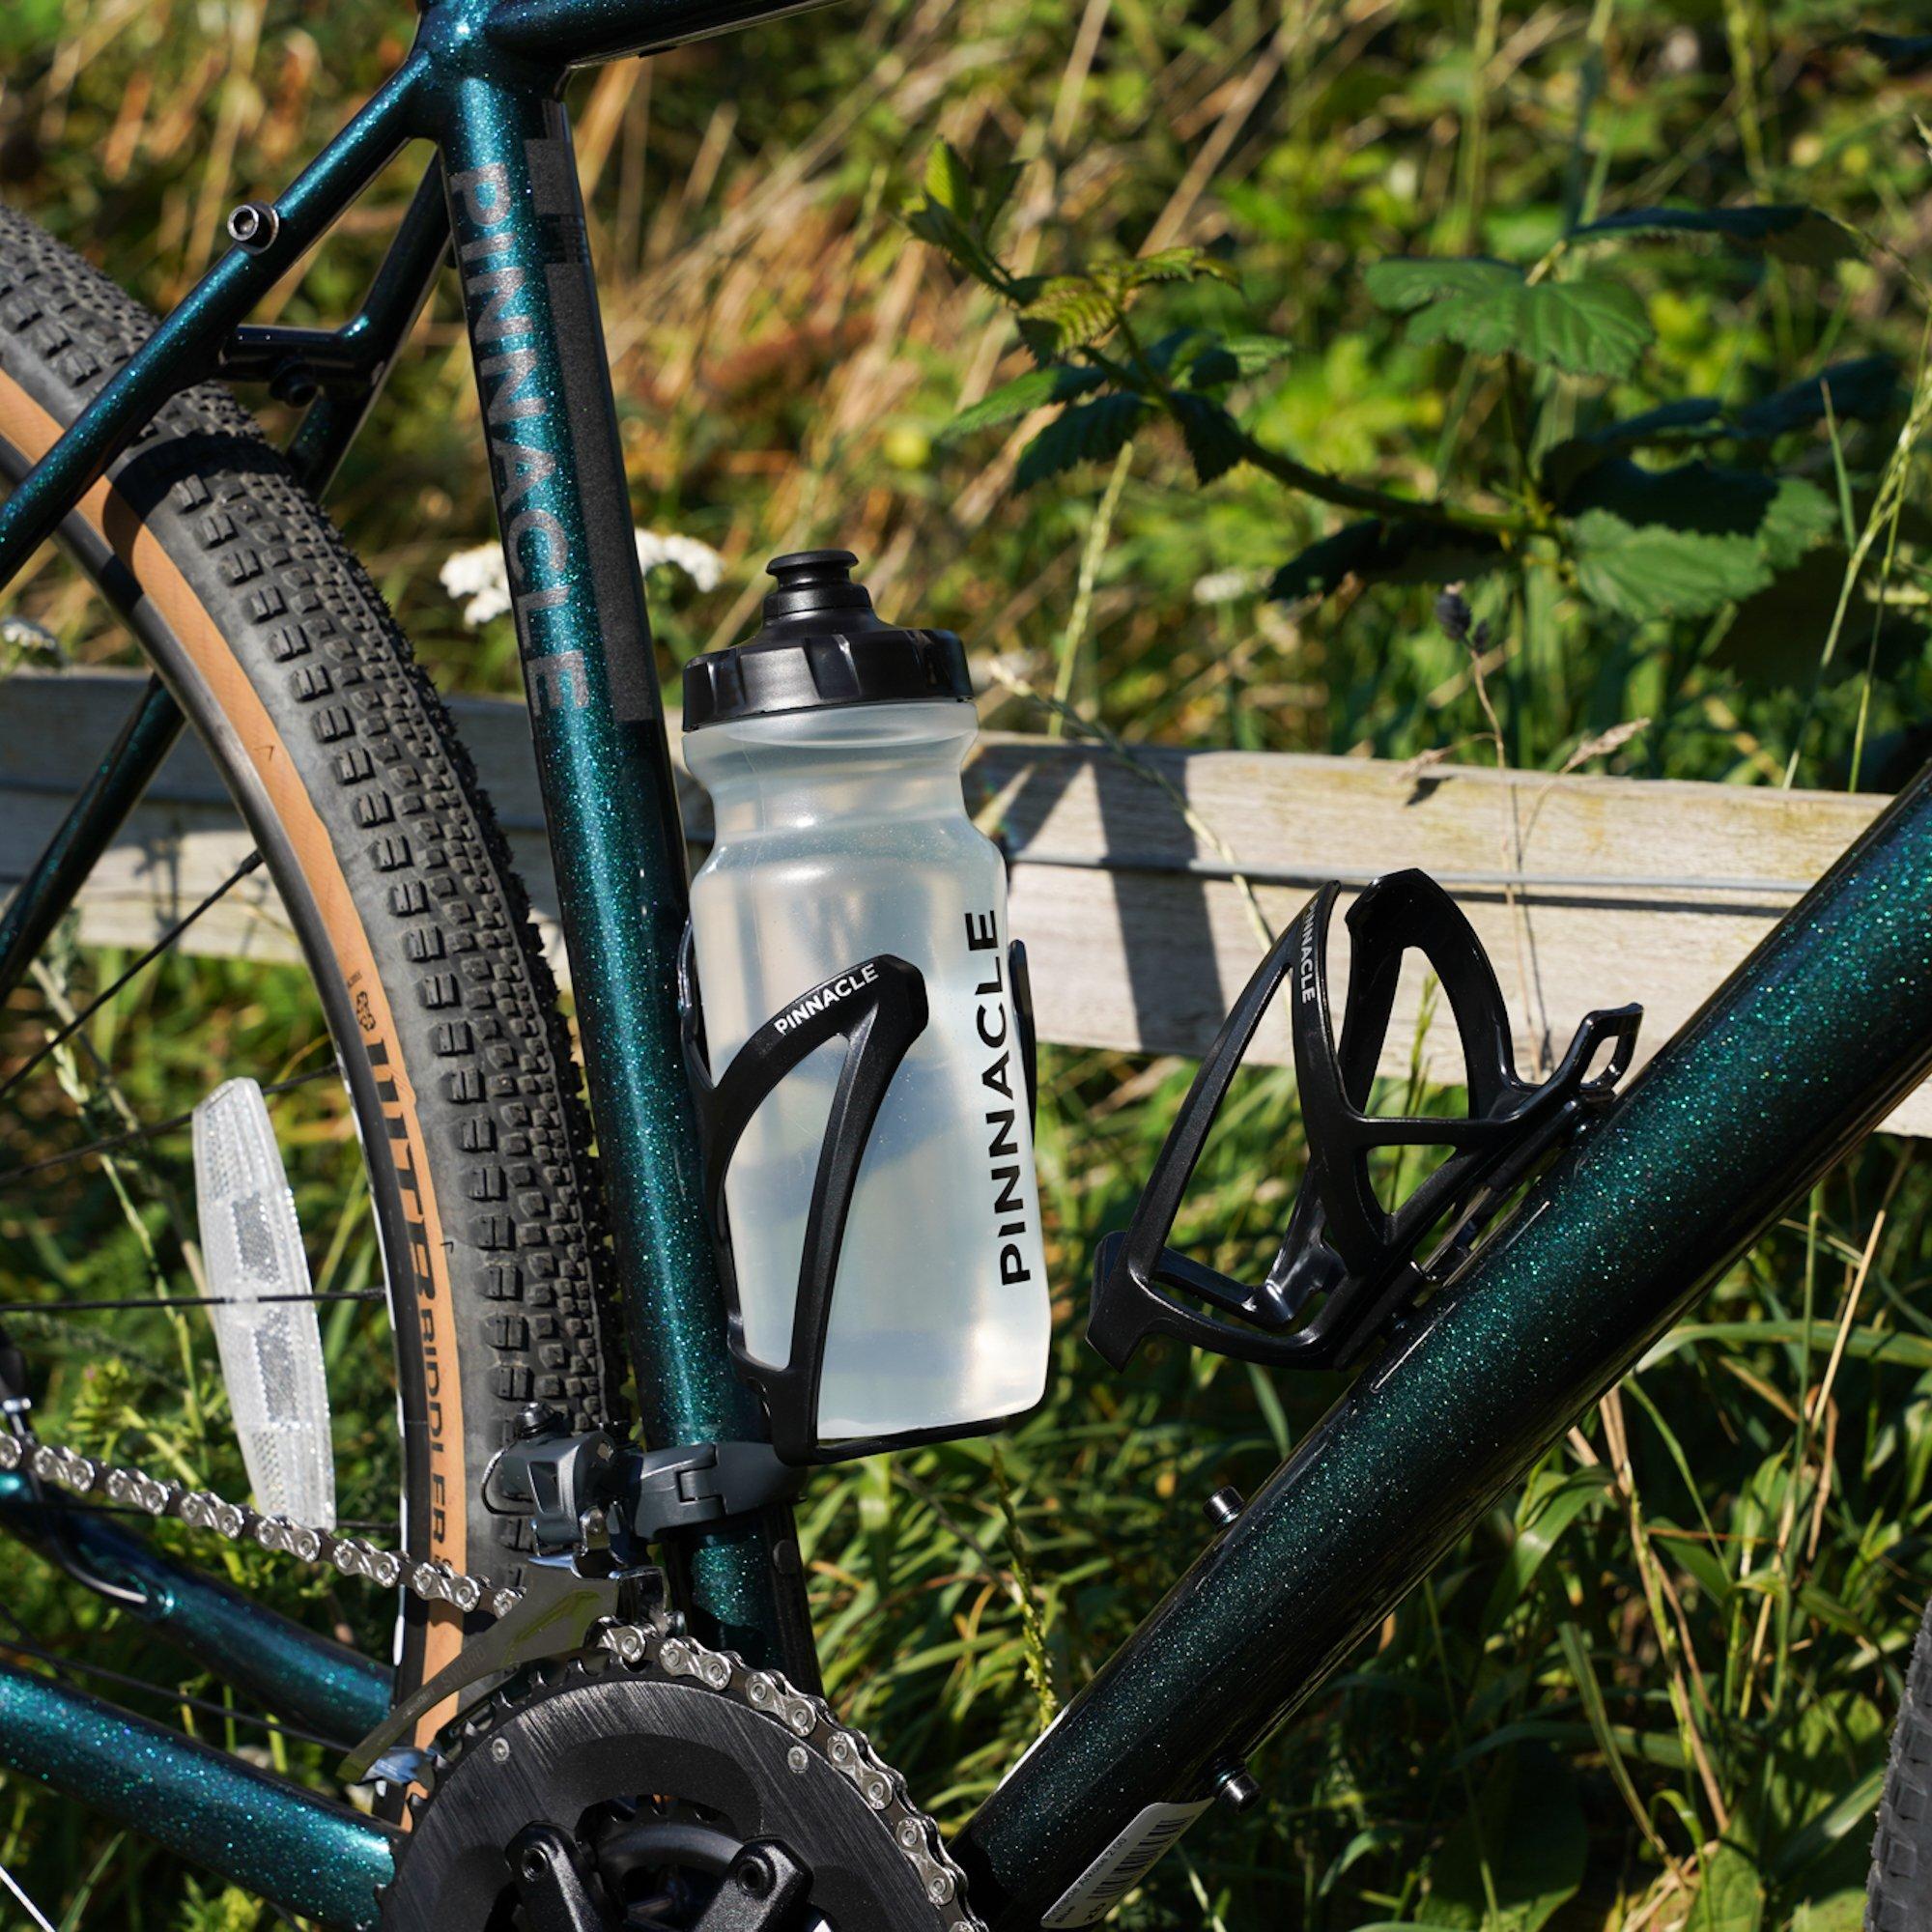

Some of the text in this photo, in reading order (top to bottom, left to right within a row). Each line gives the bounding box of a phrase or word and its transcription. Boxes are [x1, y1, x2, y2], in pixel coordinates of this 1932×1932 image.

[448, 163, 590, 717] PINNACLE
[774, 963, 879, 1036] PINNACLE
[965, 910, 1031, 1285] PINNACLE
